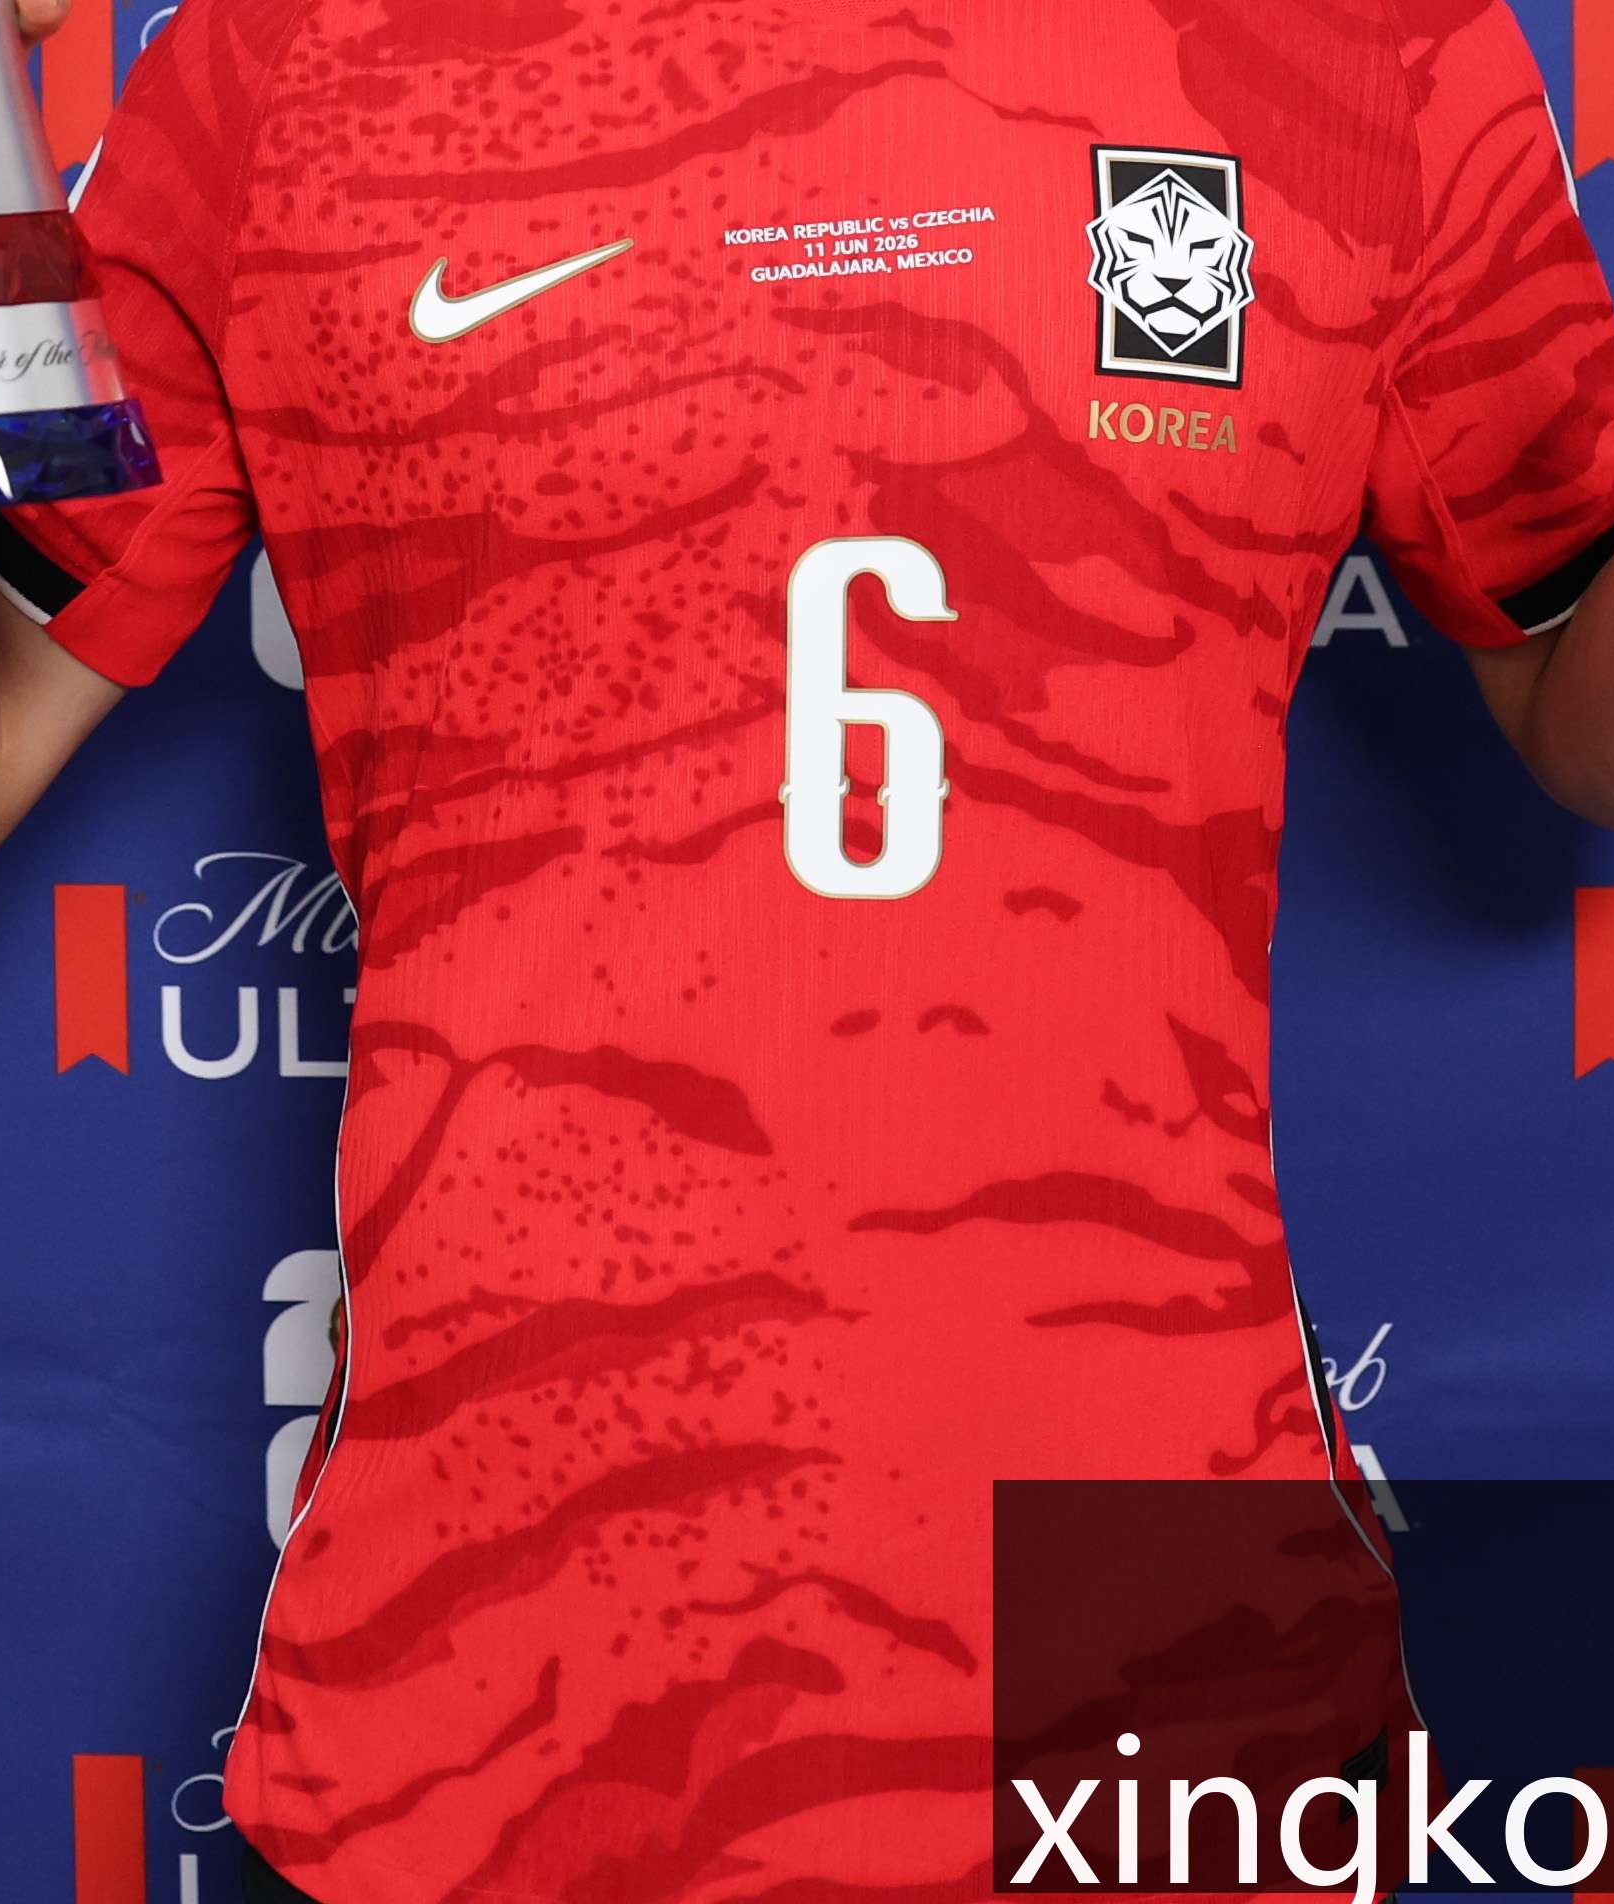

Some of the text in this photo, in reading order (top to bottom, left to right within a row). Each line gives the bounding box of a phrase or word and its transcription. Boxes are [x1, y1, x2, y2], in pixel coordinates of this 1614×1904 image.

[723, 206, 995, 245] KOREA REPUBLIC vs CZECHIA
[804, 233, 919, 258] 11 JUN 2026
[750, 247, 973, 283] GUADALAJARA, MEXICO
[0, 337, 53, 382] of
[1088, 399, 1238, 454] KOREA
[778, 535, 959, 900] 6
